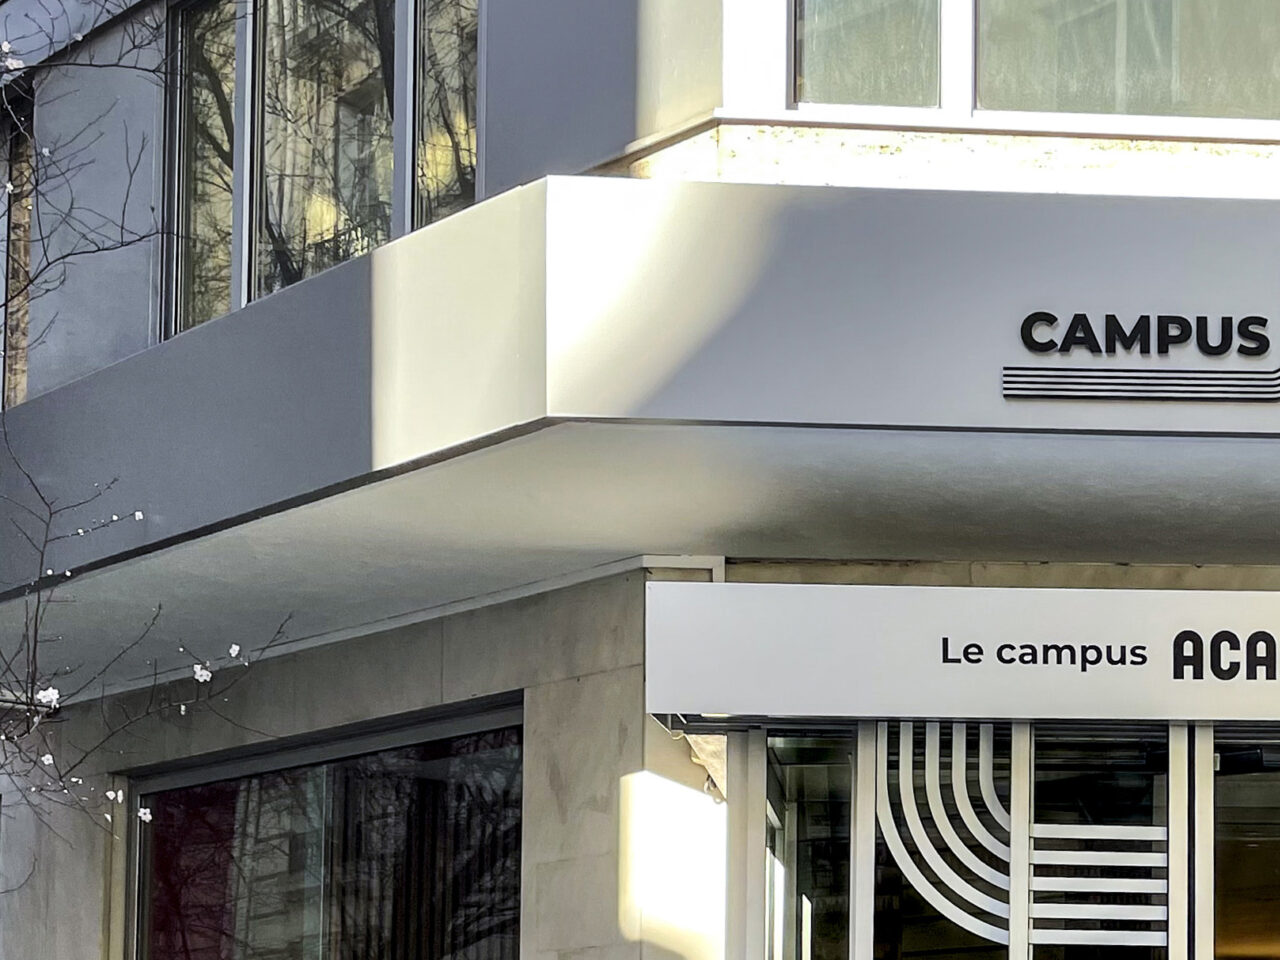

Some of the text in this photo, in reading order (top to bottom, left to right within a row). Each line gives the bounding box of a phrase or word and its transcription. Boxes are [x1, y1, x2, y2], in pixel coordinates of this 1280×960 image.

[1020, 311, 1271, 357] CAMPUS
[941, 636, 985, 665] Le
[995, 643, 1148, 673] campus
